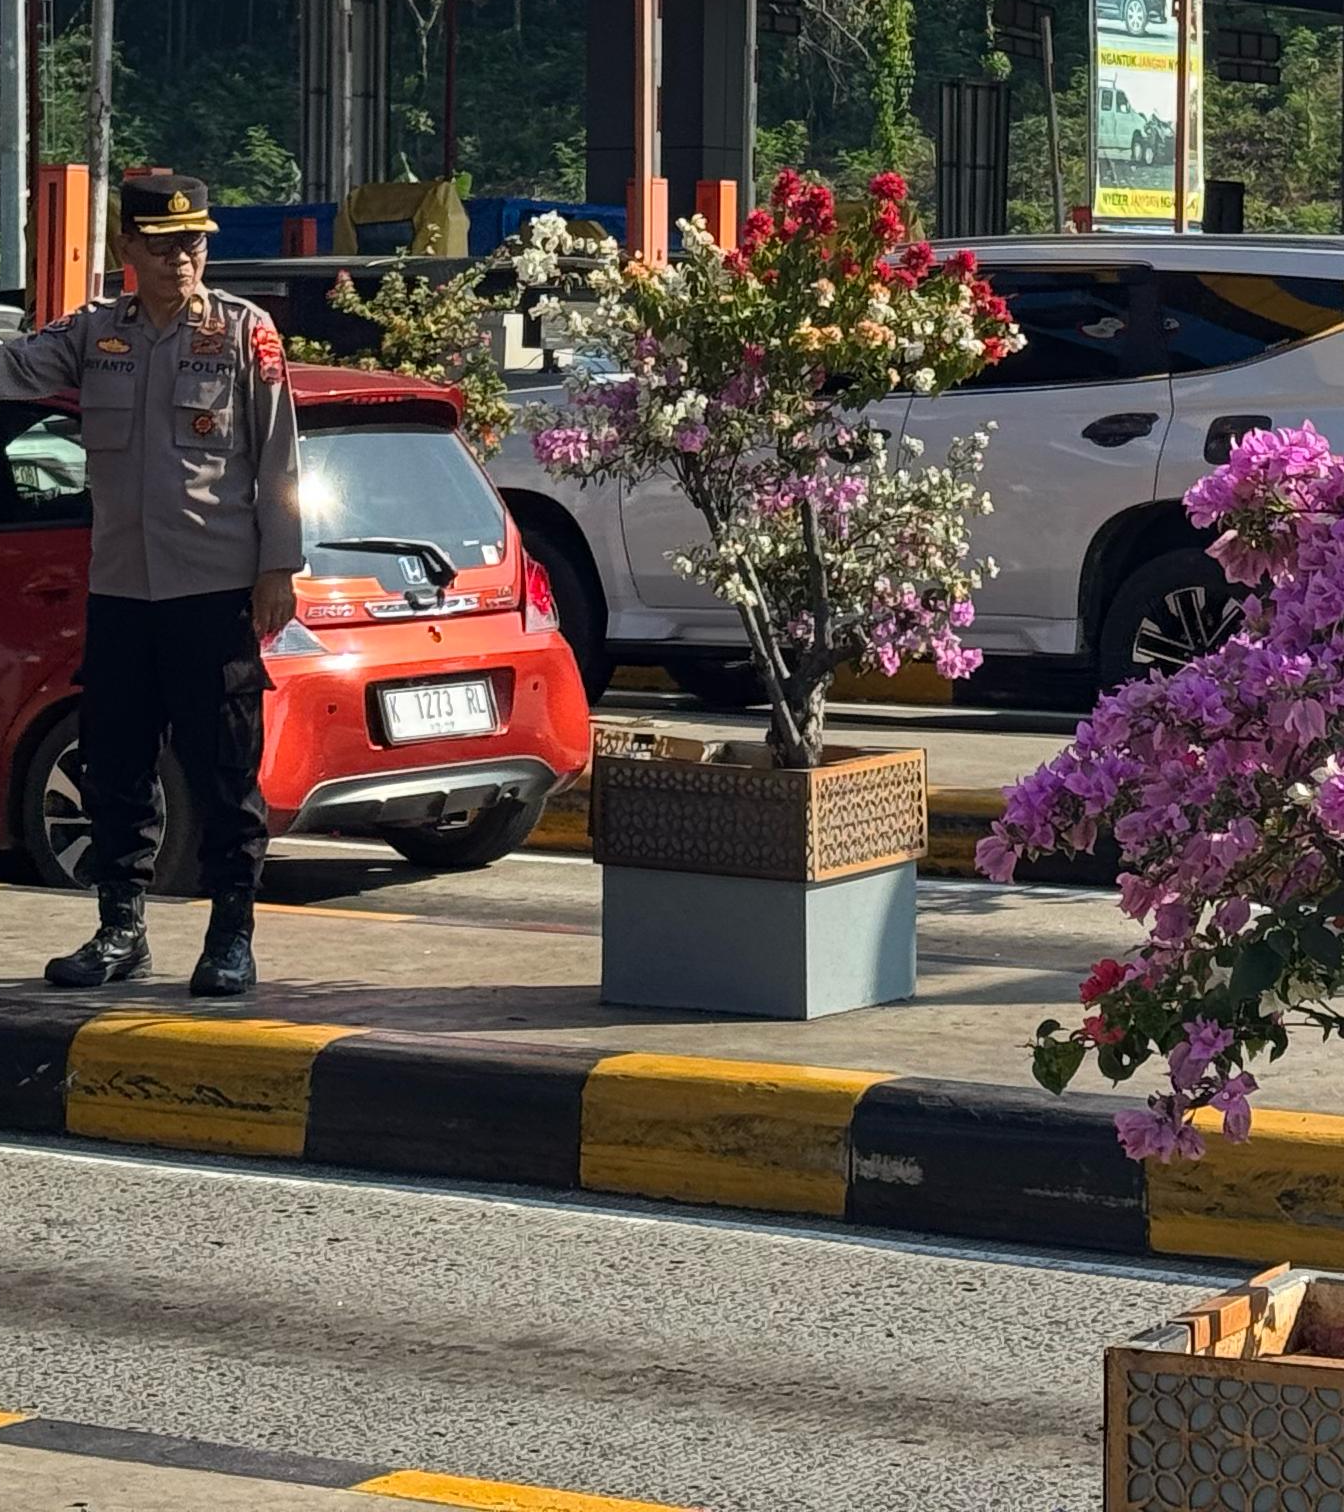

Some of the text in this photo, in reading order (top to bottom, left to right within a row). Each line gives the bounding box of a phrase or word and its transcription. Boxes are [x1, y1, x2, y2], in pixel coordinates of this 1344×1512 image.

[178, 360, 234, 376] POLRI
[389, 686, 487, 723] K 1273 RL
